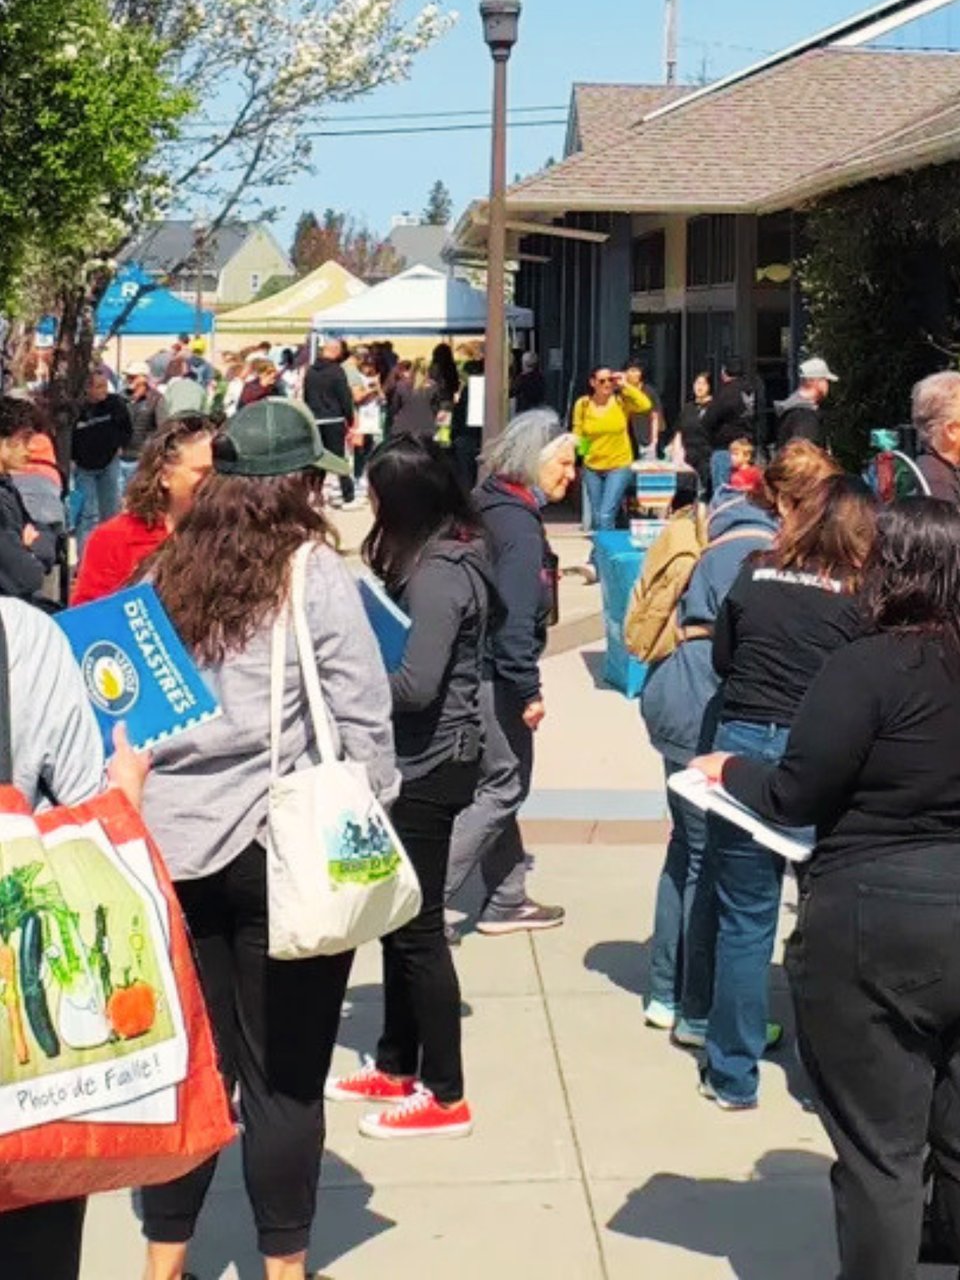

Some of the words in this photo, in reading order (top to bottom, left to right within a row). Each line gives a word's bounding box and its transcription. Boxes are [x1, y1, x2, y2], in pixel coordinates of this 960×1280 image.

[123, 600, 192, 714] DESASTRES
[16, 1088, 68, 1110] Photo
[74, 1074, 96, 1098] de
